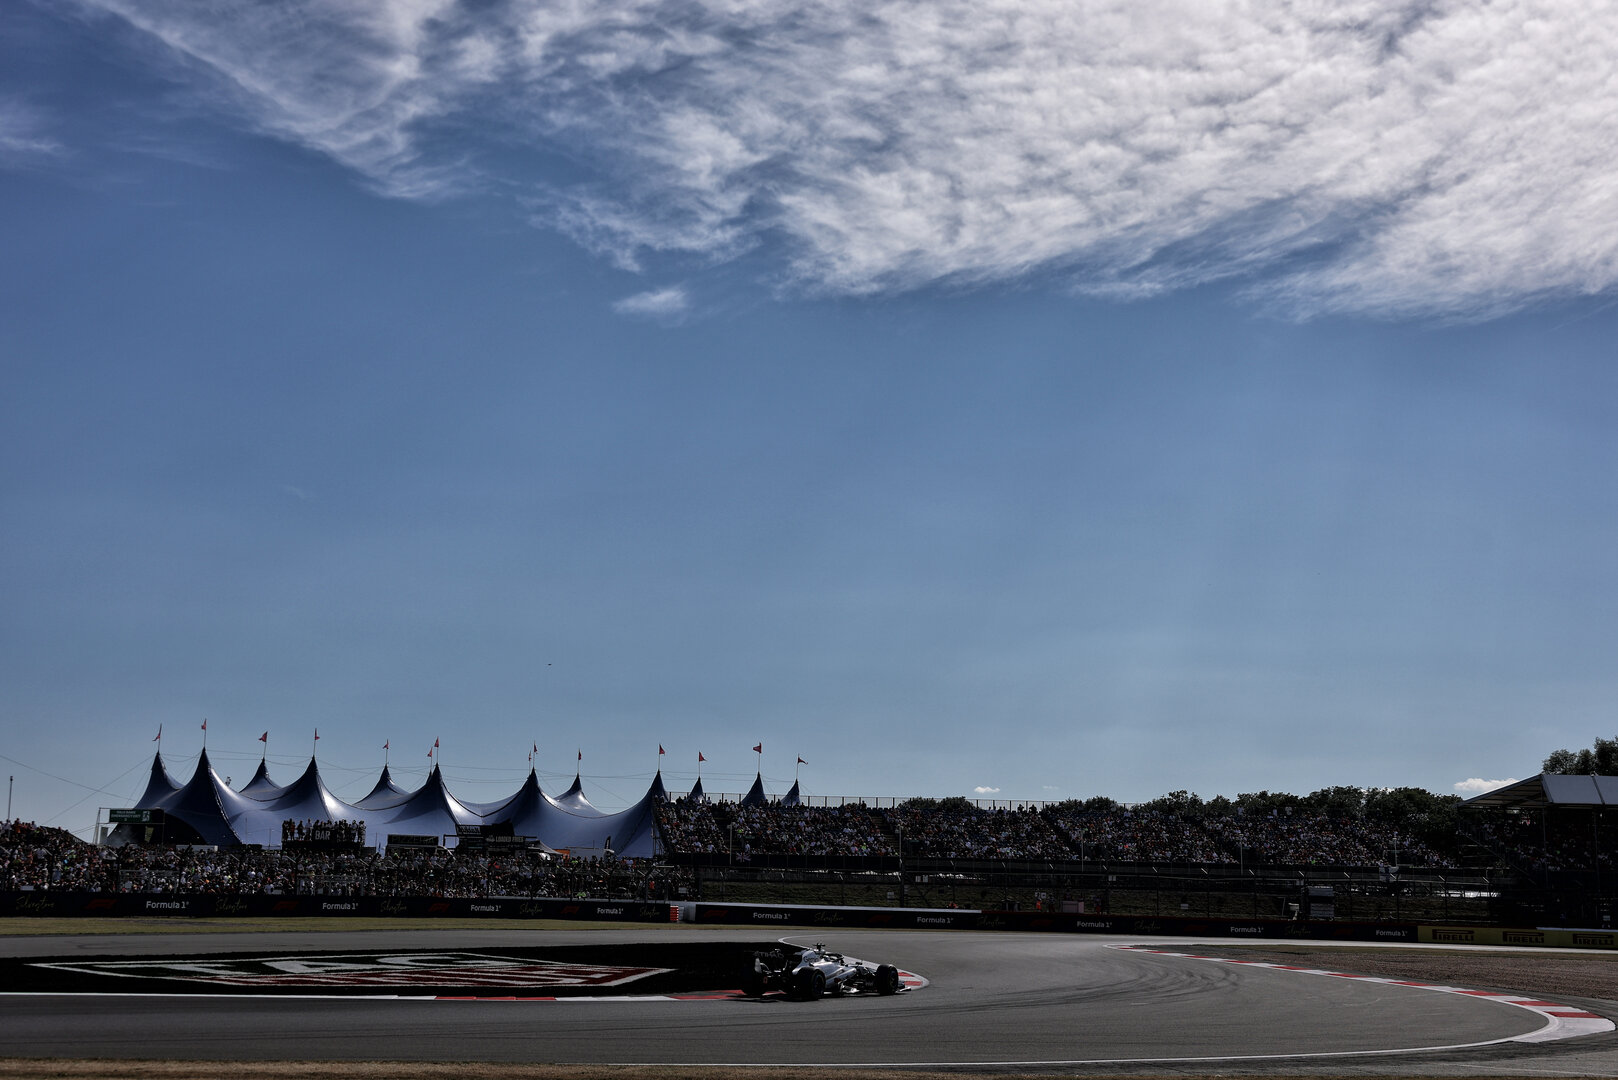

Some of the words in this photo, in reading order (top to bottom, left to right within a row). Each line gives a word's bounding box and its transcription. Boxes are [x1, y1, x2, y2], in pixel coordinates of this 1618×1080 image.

[315, 830, 331, 841] BAR
[146, 901, 181, 909] Formula
[1432, 929, 1475, 941] PIRELLI
[1502, 931, 1544, 943] PIRELLI
[1573, 933, 1614, 945] PIRELLI
[92, 955, 525, 975] TAG
